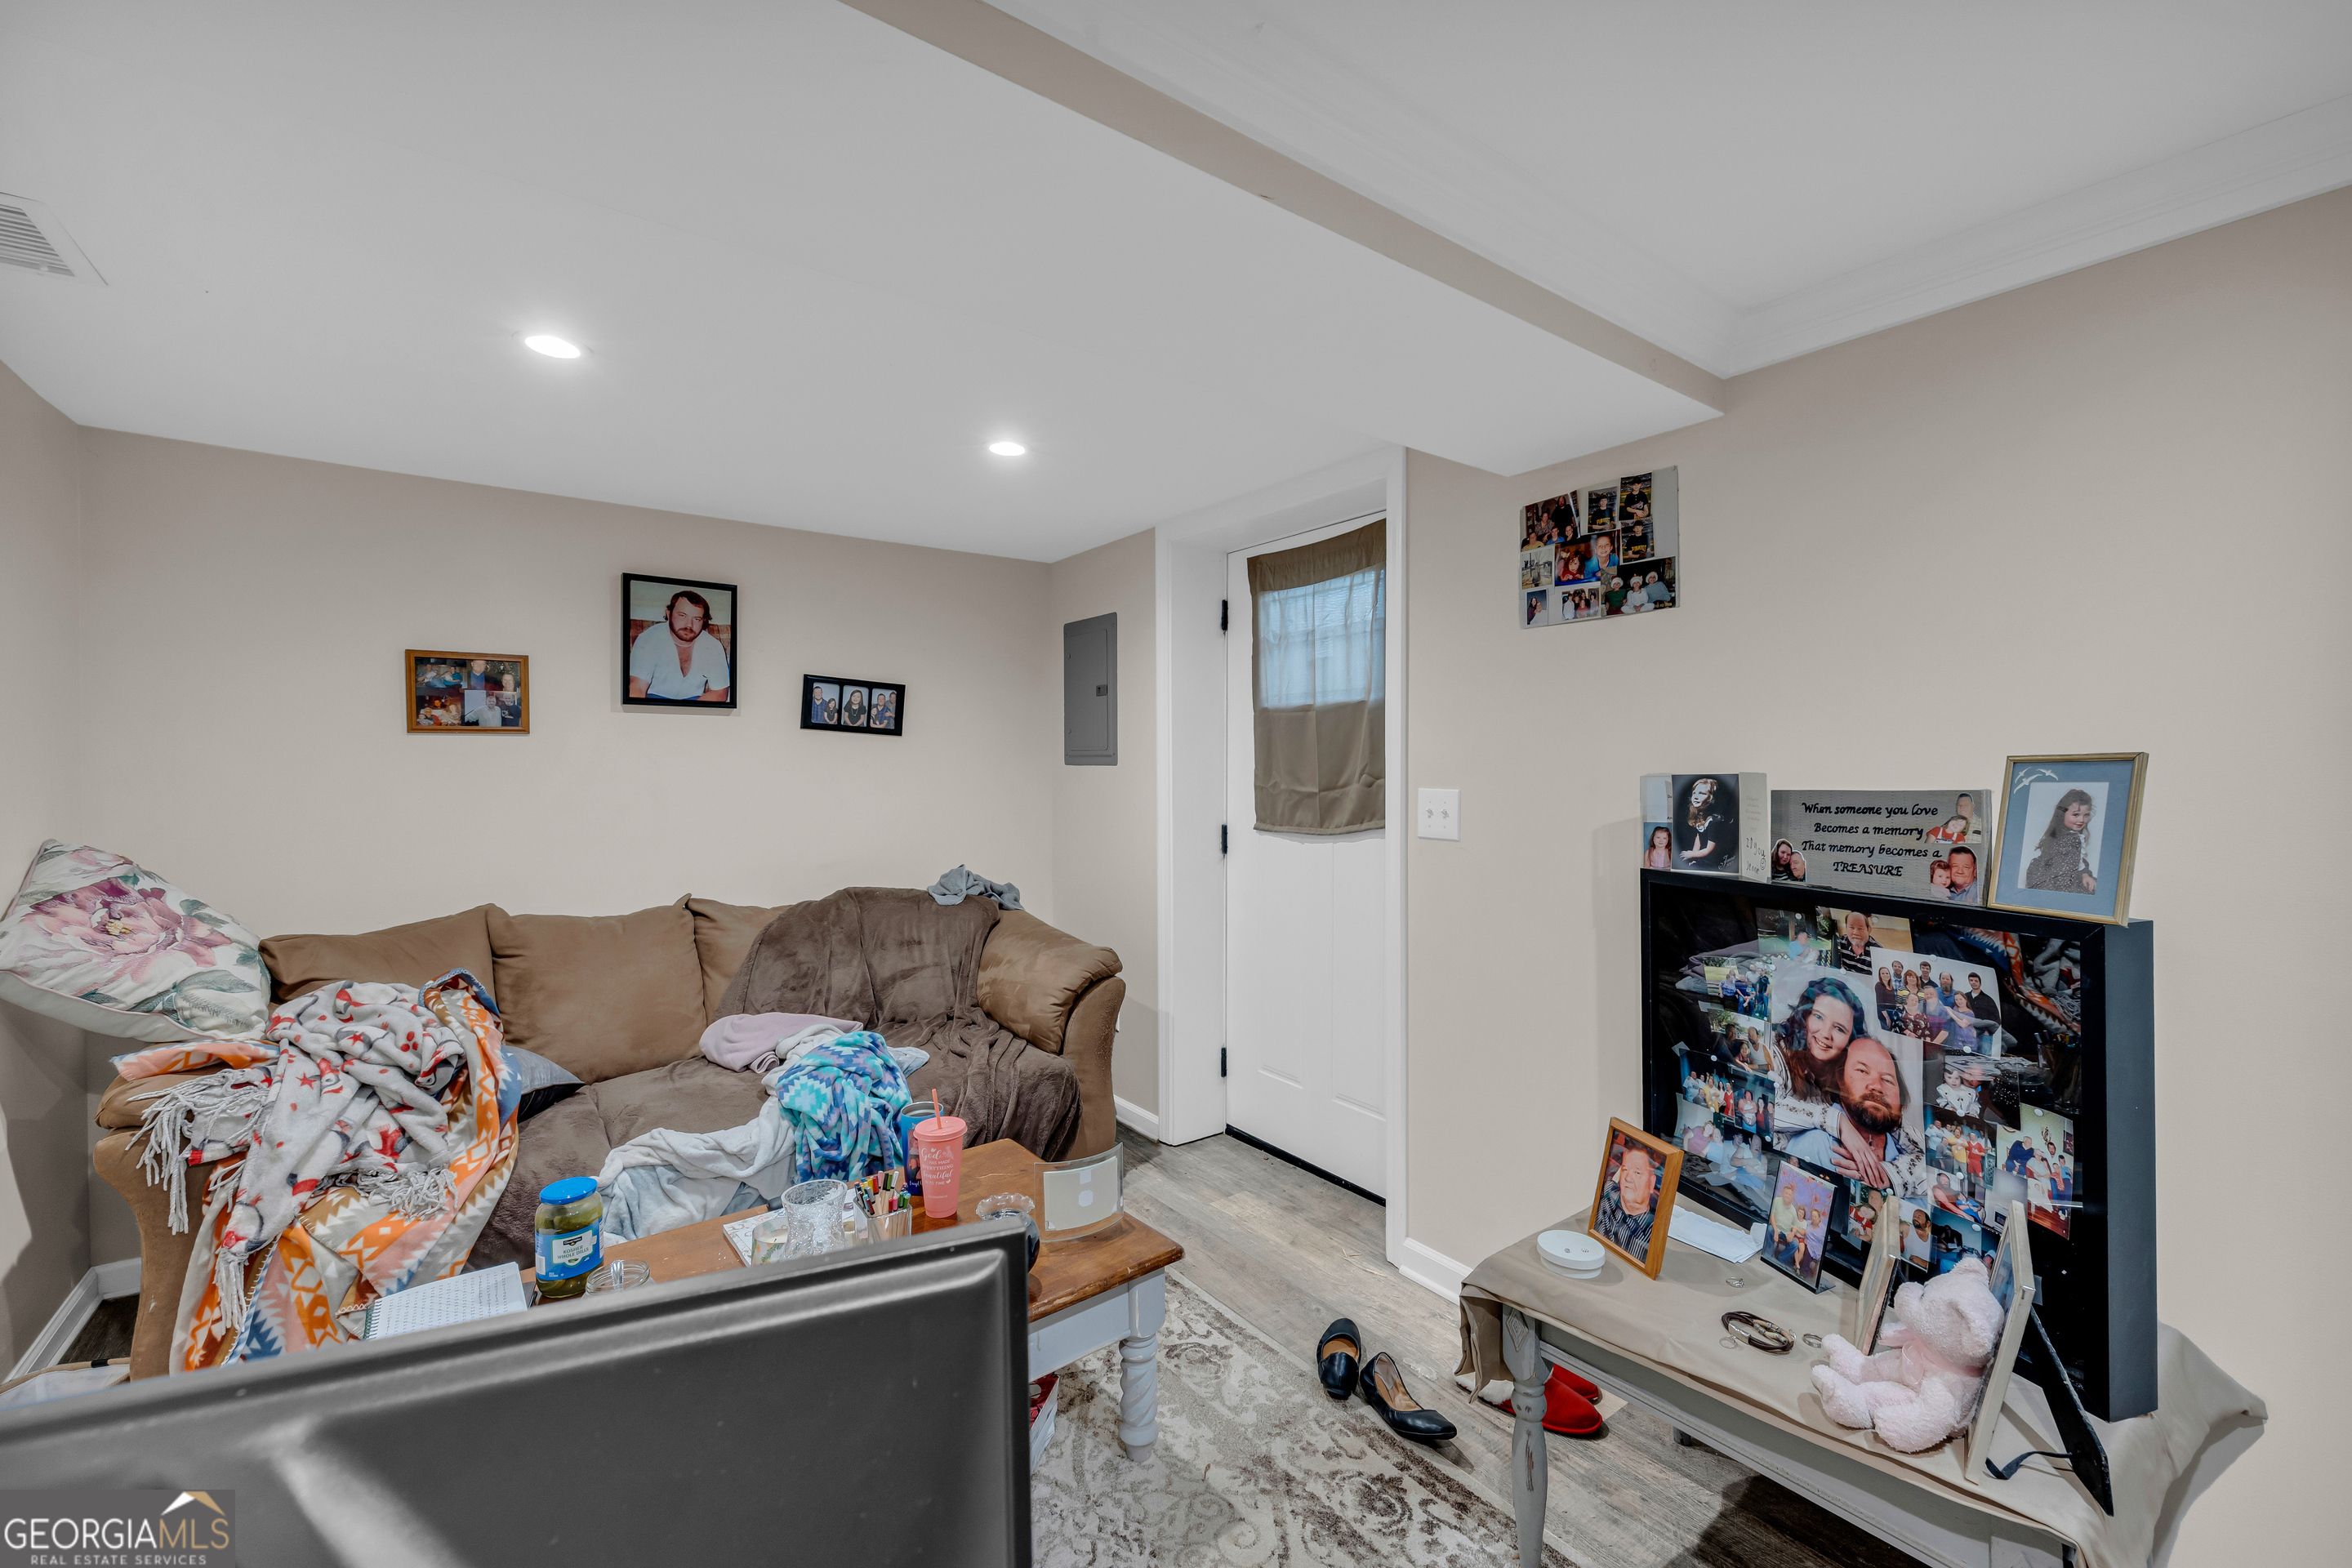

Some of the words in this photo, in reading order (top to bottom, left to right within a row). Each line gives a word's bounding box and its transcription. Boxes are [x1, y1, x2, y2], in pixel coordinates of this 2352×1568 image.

[1802, 803, 1832, 814] When
[1834, 804, 1882, 815] someone
[1885, 806, 1909, 818] you
[1911, 804, 1938, 816] love
[1814, 822, 1860, 834] Becomes
[1862, 826, 1870, 835] a
[1873, 826, 1923, 840] memory
[1802, 840, 1826, 852] That
[1829, 843, 1875, 858] memory
[1878, 844, 1928, 858] becomes
[1932, 849, 1942, 858] a
[1833, 862, 1904, 876] TREASURE
[921, 1148, 942, 1160] God
[923, 1169, 953, 1179] beautiful
[557, 1251, 575, 1259] WHOLE
[564, 1245, 583, 1254] KOSHER
